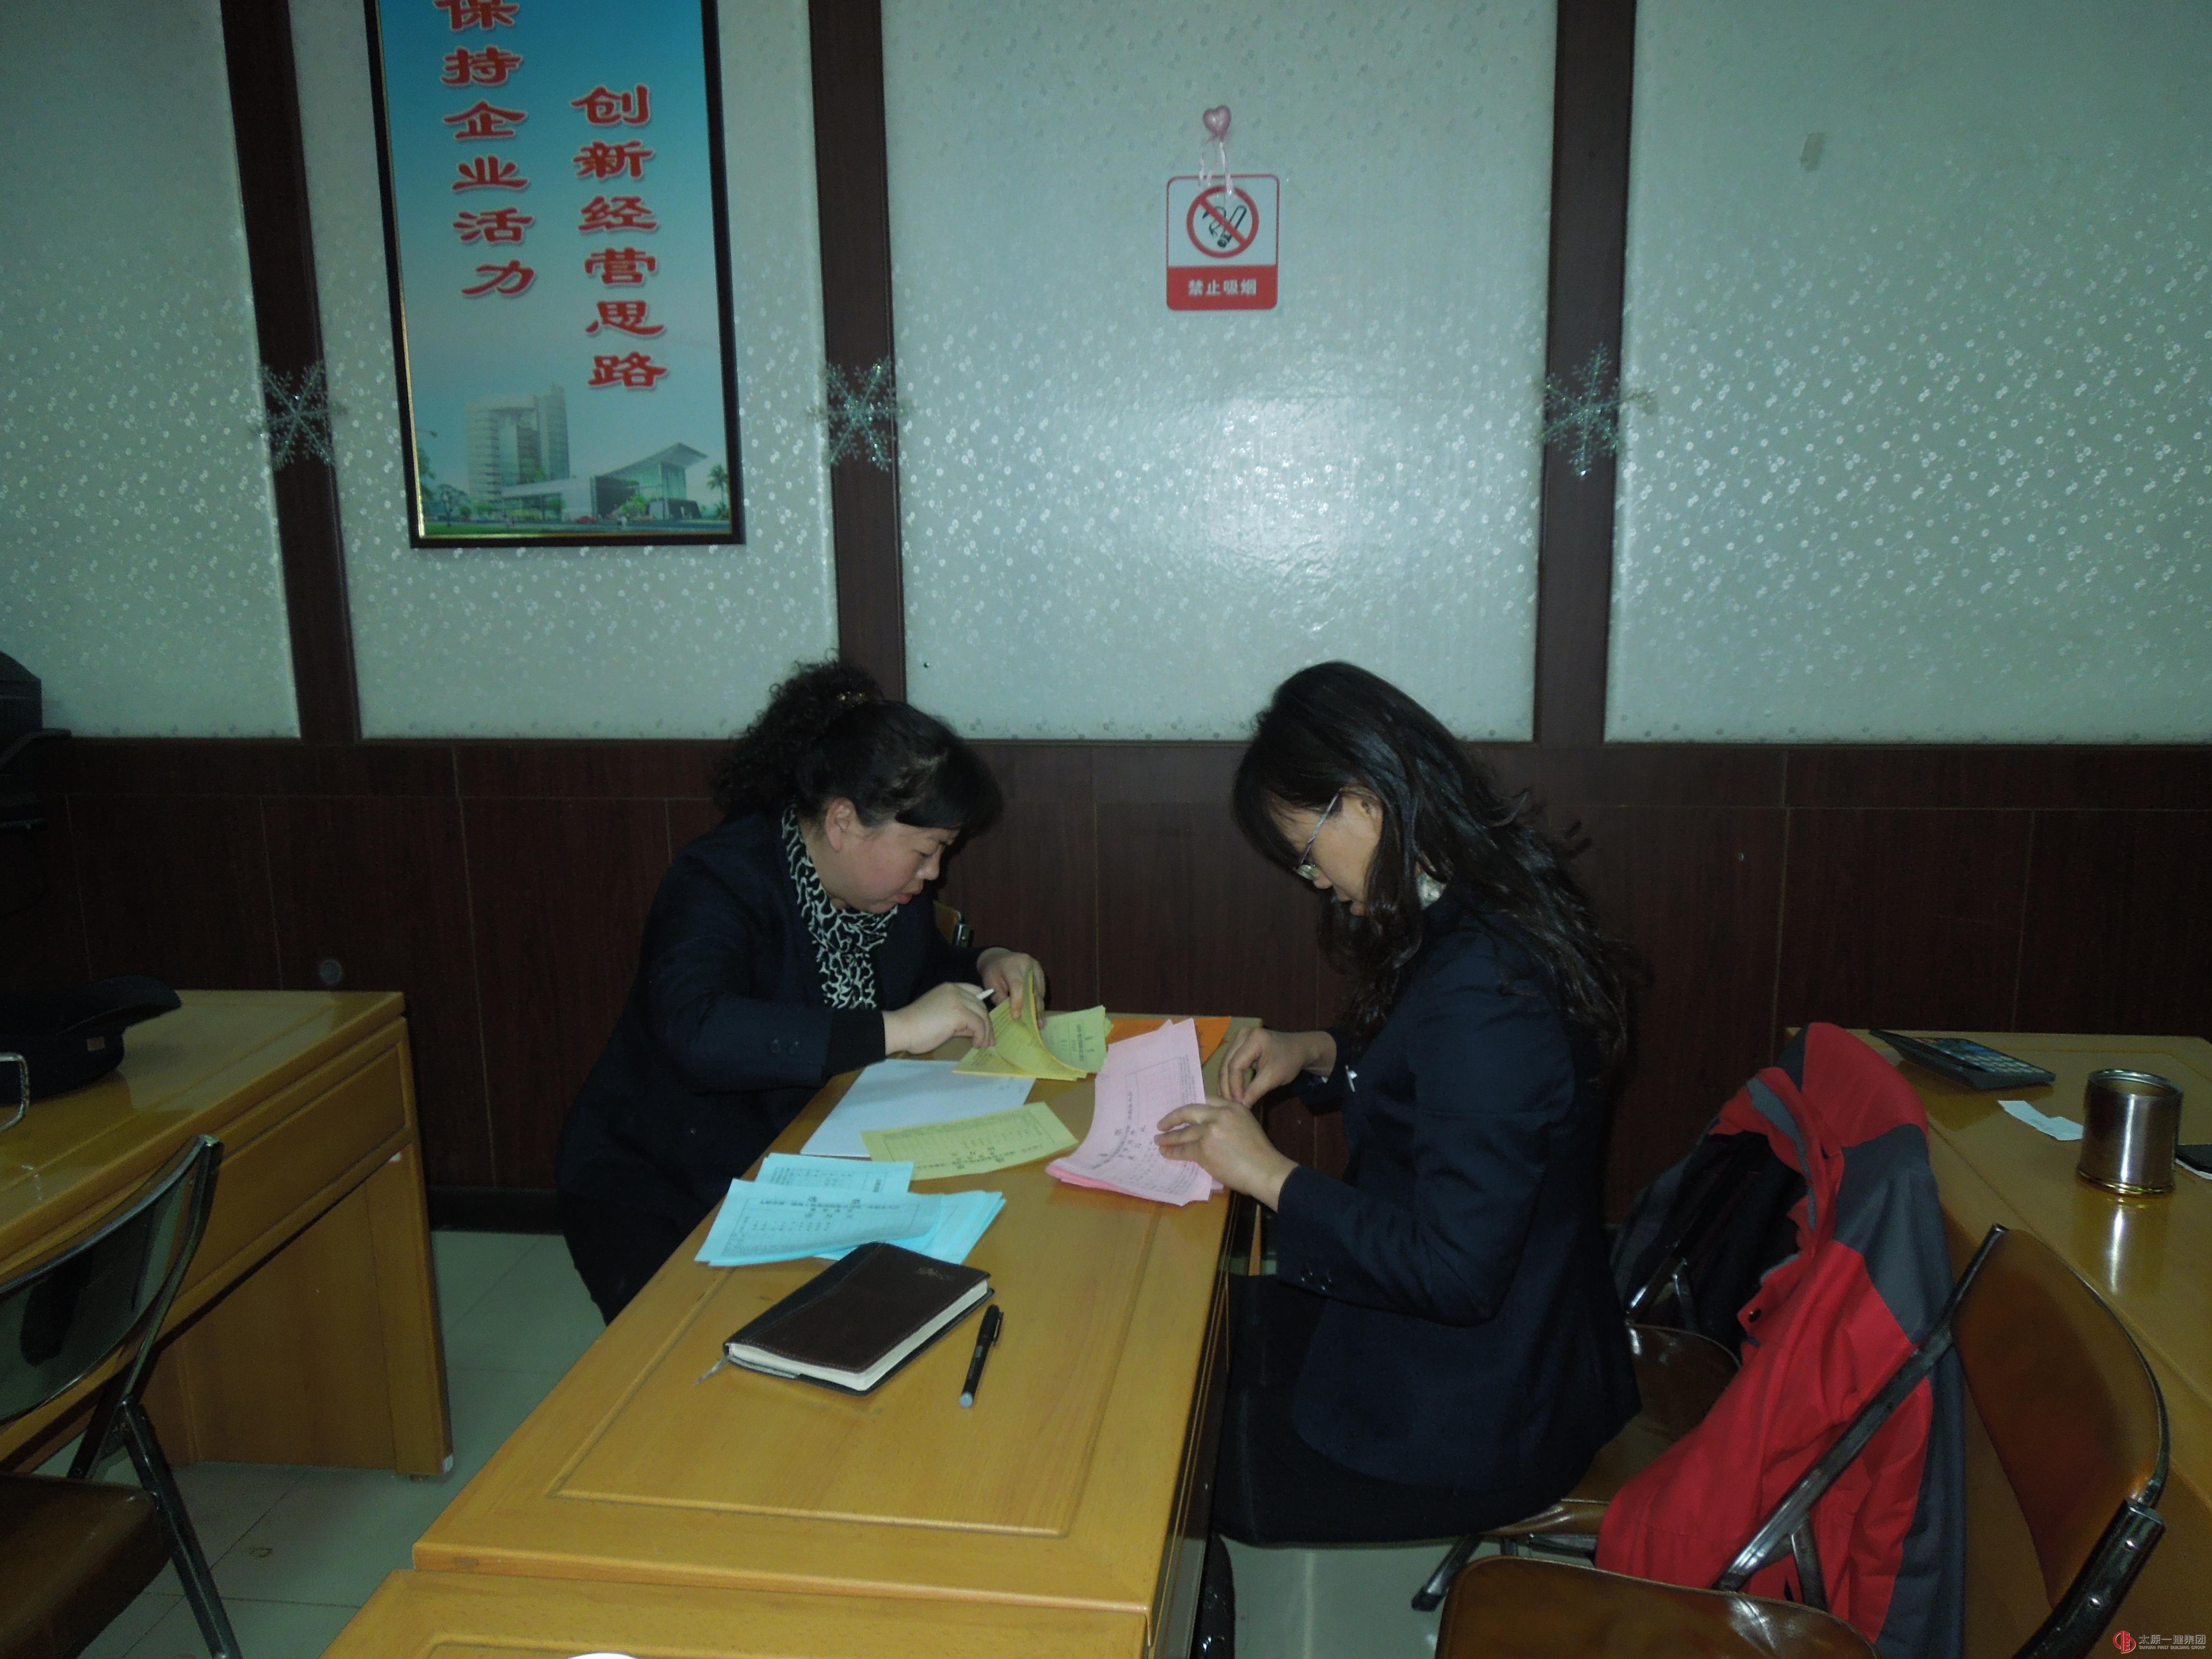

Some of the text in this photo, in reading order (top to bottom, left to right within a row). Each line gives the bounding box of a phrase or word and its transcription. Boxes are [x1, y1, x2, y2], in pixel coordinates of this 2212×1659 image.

[435, 0, 535, 297] 保持企业活力
[572, 84, 667, 388] 创新经营思路
[1188, 278, 1257, 296] 禁止吸烟
